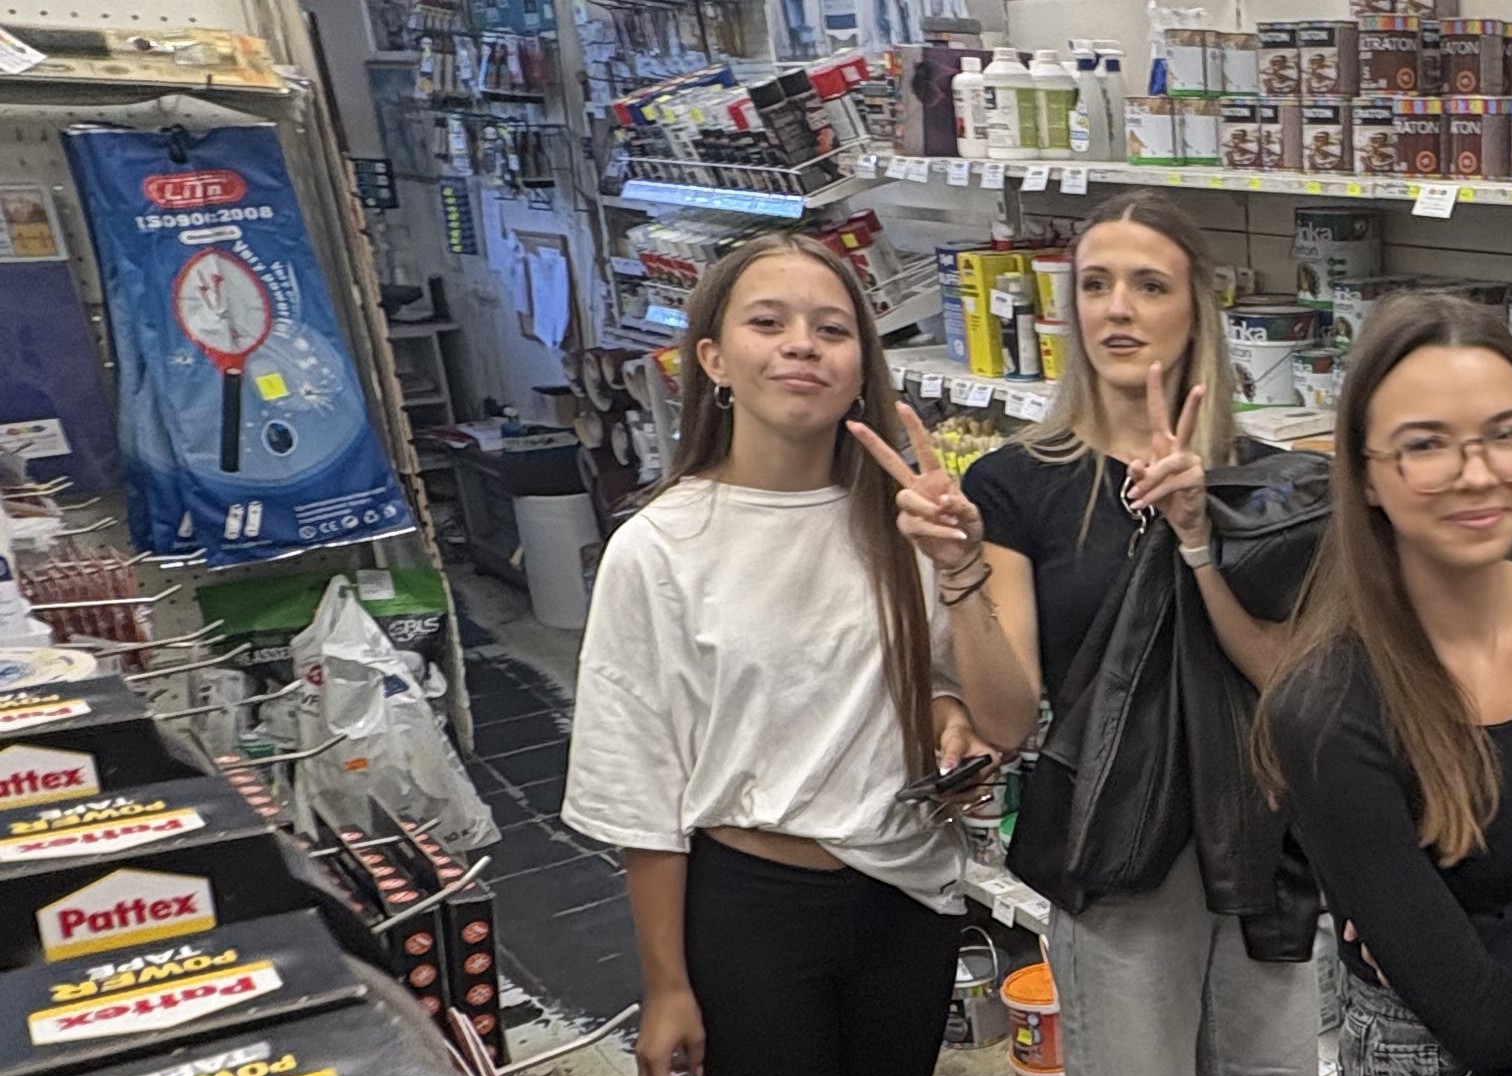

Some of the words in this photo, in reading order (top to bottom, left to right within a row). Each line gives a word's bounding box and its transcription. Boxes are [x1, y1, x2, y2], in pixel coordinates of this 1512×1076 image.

[0, 766, 84, 798] attex
[57, 892, 199, 939] Pattex
[48, 949, 239, 1002] POWER
[86, 945, 205, 981] TAPE
[55, 976, 257, 1032] Pattex
